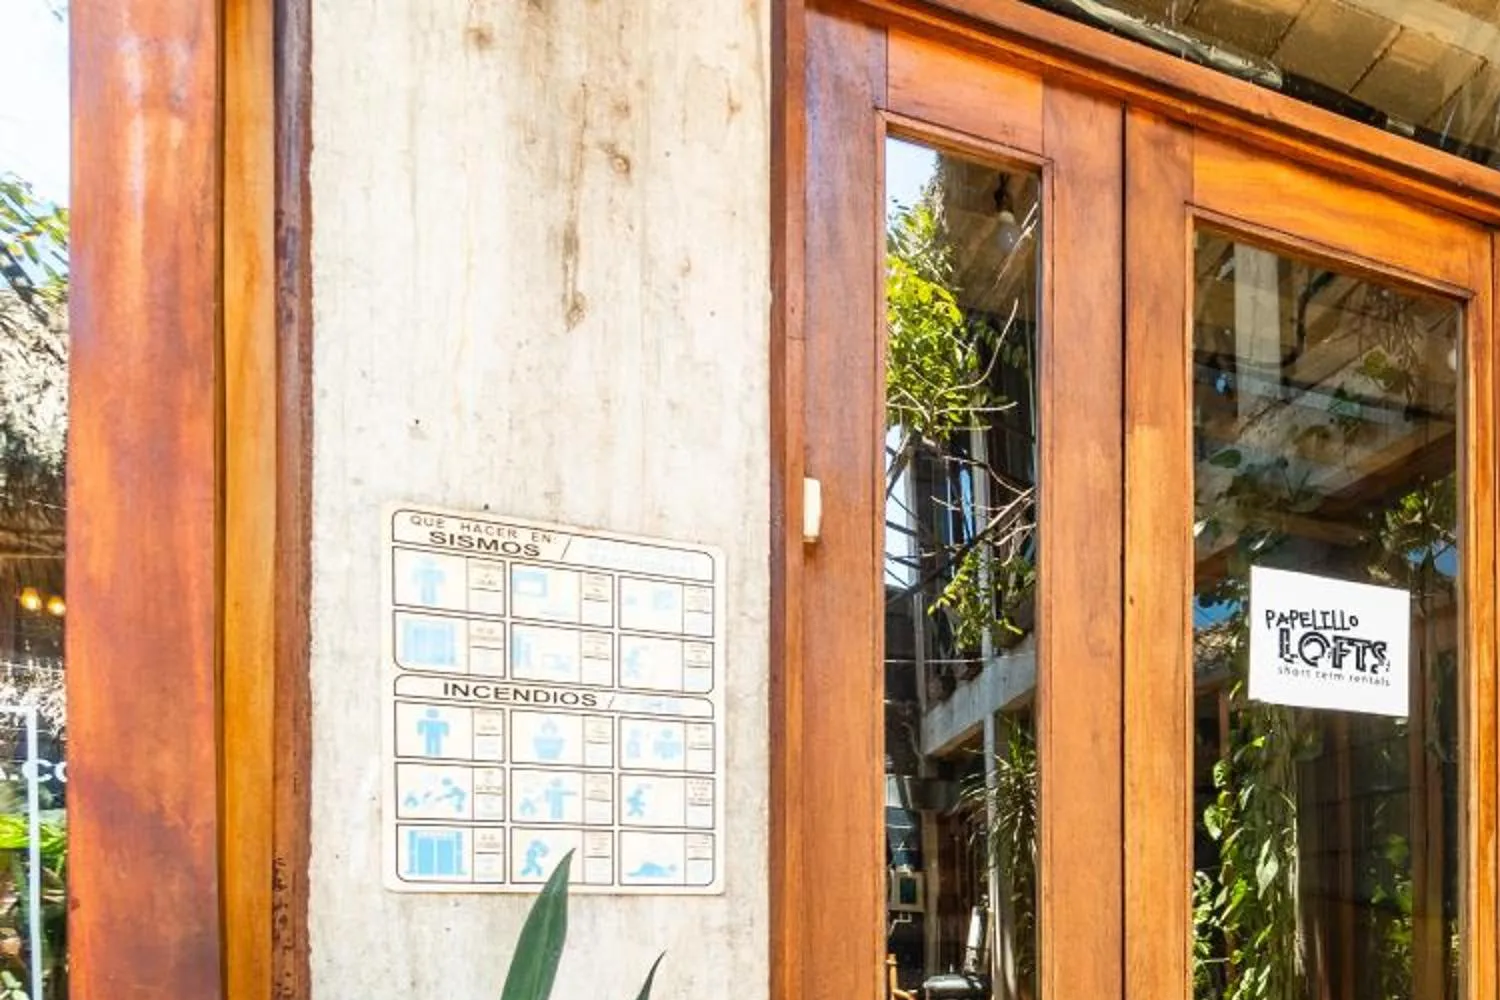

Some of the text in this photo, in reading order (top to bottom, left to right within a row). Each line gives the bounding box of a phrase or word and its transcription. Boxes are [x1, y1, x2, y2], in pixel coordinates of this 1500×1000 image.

[409, 515, 446, 529] QUE
[460, 522, 519, 538] HACER
[429, 531, 541, 557] SISMOS
[1278, 627, 1388, 674] LOFTS
[1349, 674, 1390, 687] rentals
[443, 682, 598, 707] INCENDIOS
